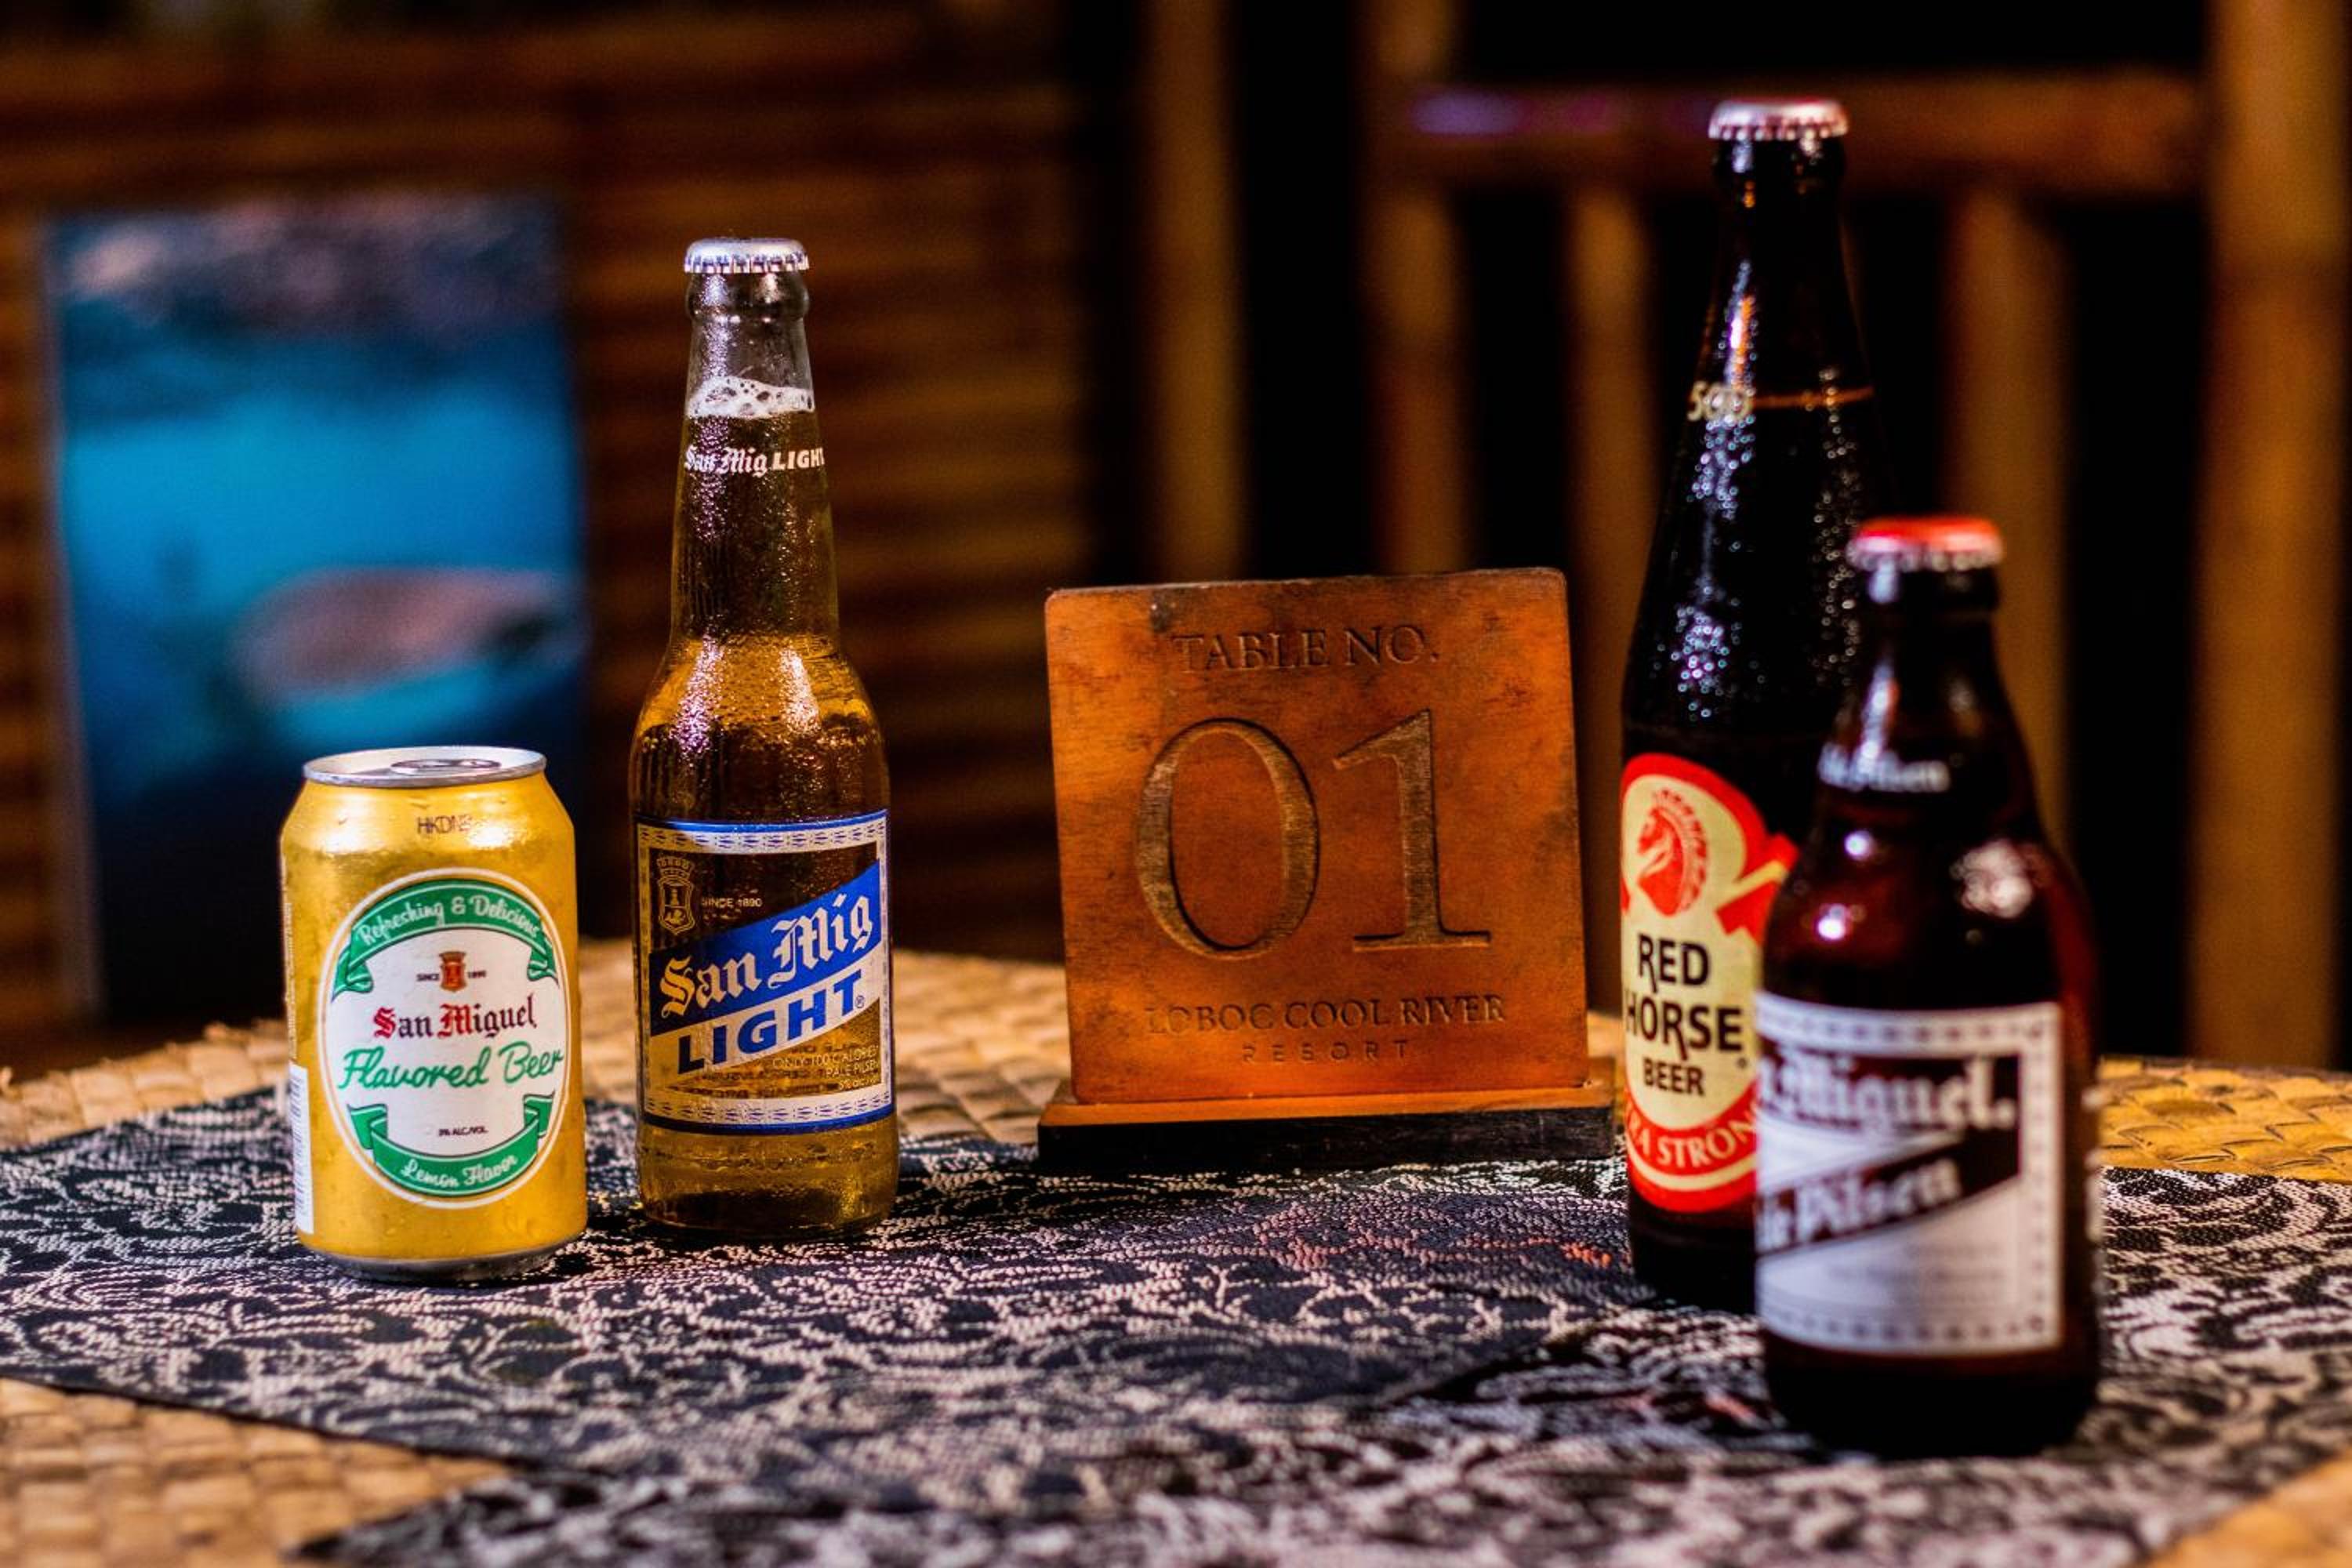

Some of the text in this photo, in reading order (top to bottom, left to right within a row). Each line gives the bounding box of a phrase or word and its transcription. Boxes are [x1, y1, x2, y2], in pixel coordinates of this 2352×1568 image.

[714, 446, 768, 478] Mig
[771, 447, 826, 470] LIGH
[1171, 623, 1440, 673] TABLE NO.
[1136, 708, 1491, 962] 01
[358, 894, 541, 946] Refreshing & Delicious
[660, 893, 874, 1019] San Mig
[1638, 933, 1710, 994] RED
[372, 992, 538, 1040] San Miguel
[677, 968, 862, 1075] LIGHT
[1145, 993, 1505, 1036] LOBOC COOL RIVER
[1624, 989, 1744, 1061] HORSE
[338, 1040, 564, 1091] Flavored Beer
[1242, 1039, 1410, 1062] RESORT
[1642, 1056, 1705, 1097] BEER
[1656, 1099, 1759, 1168] STRON
[400, 1154, 519, 1189] Lemon Flavor
